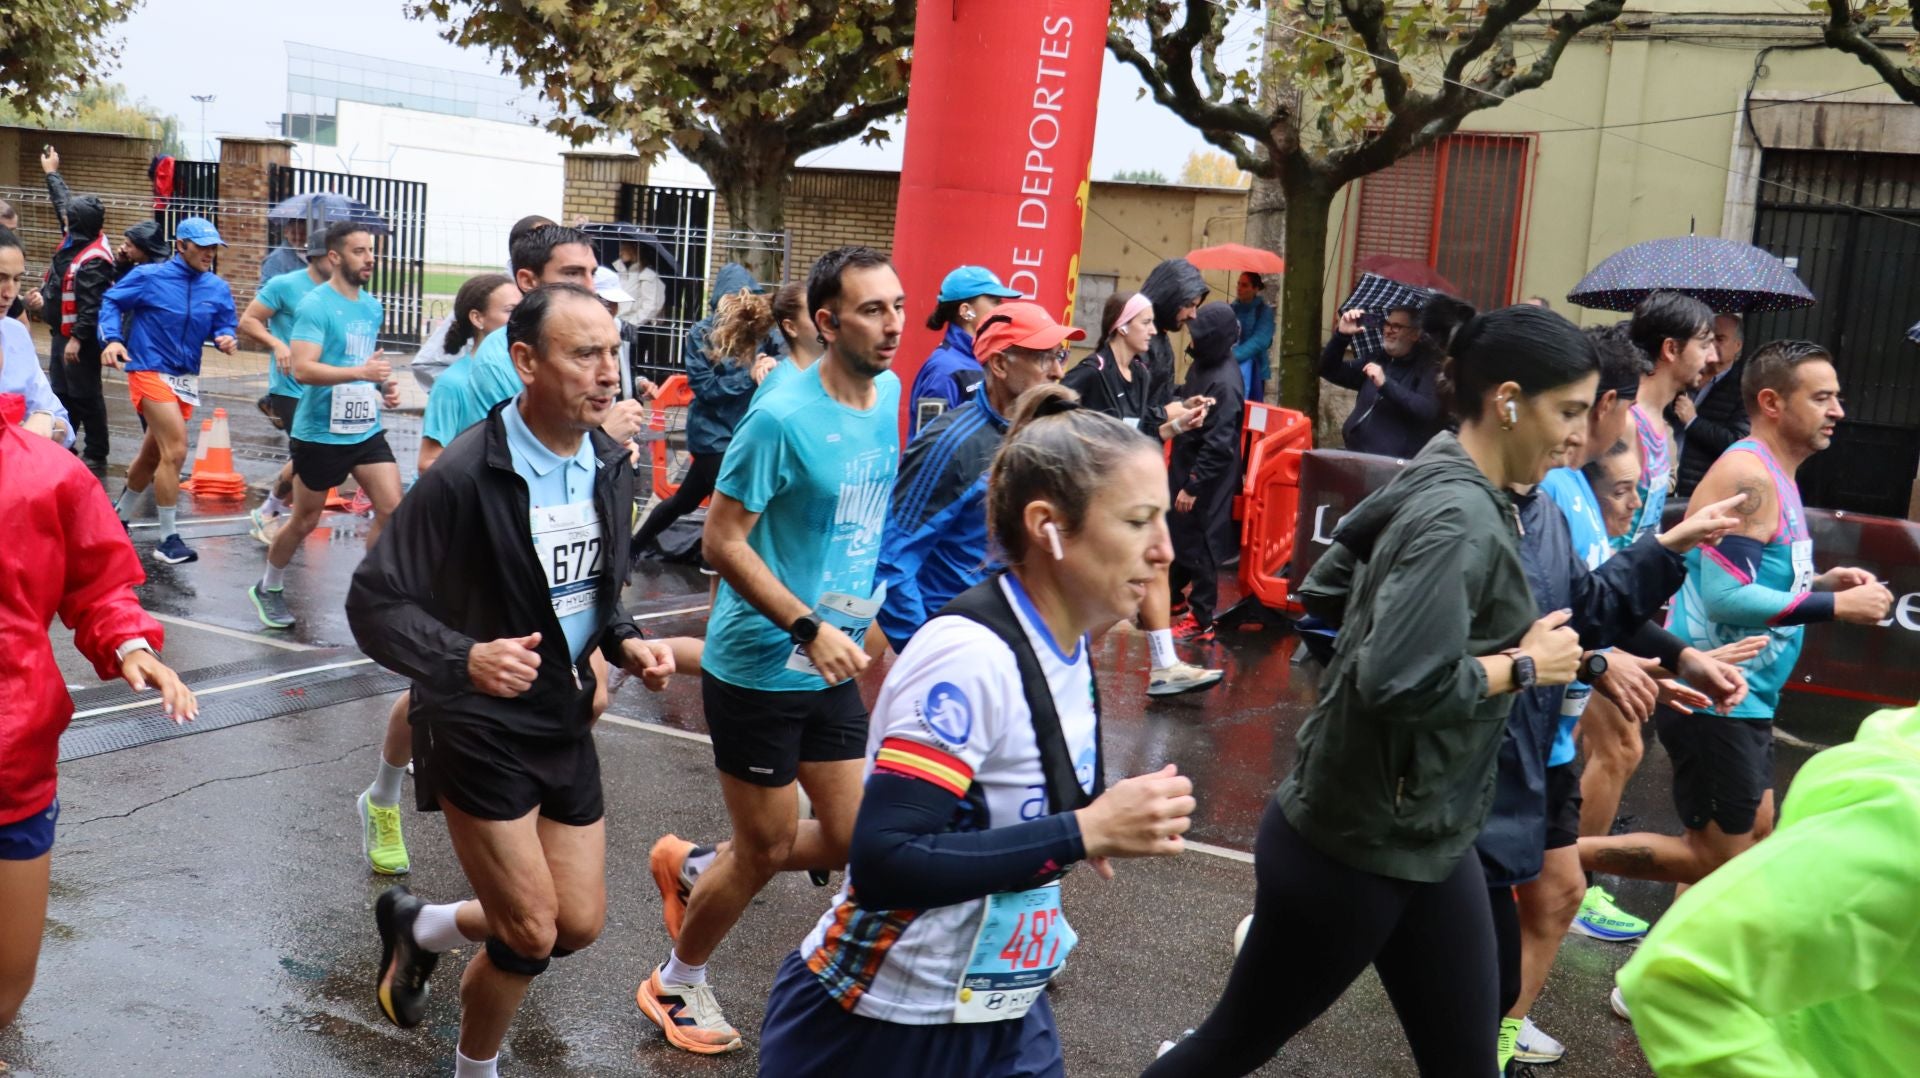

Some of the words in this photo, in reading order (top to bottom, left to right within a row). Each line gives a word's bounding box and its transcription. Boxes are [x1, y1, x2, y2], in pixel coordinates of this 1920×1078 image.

[1017, 15, 1073, 229] DEPORTES
[1009, 247, 1044, 300] DE
[345, 401, 369, 419] 809
[553, 536, 601, 585] 672
[999, 907, 1061, 970] 487
